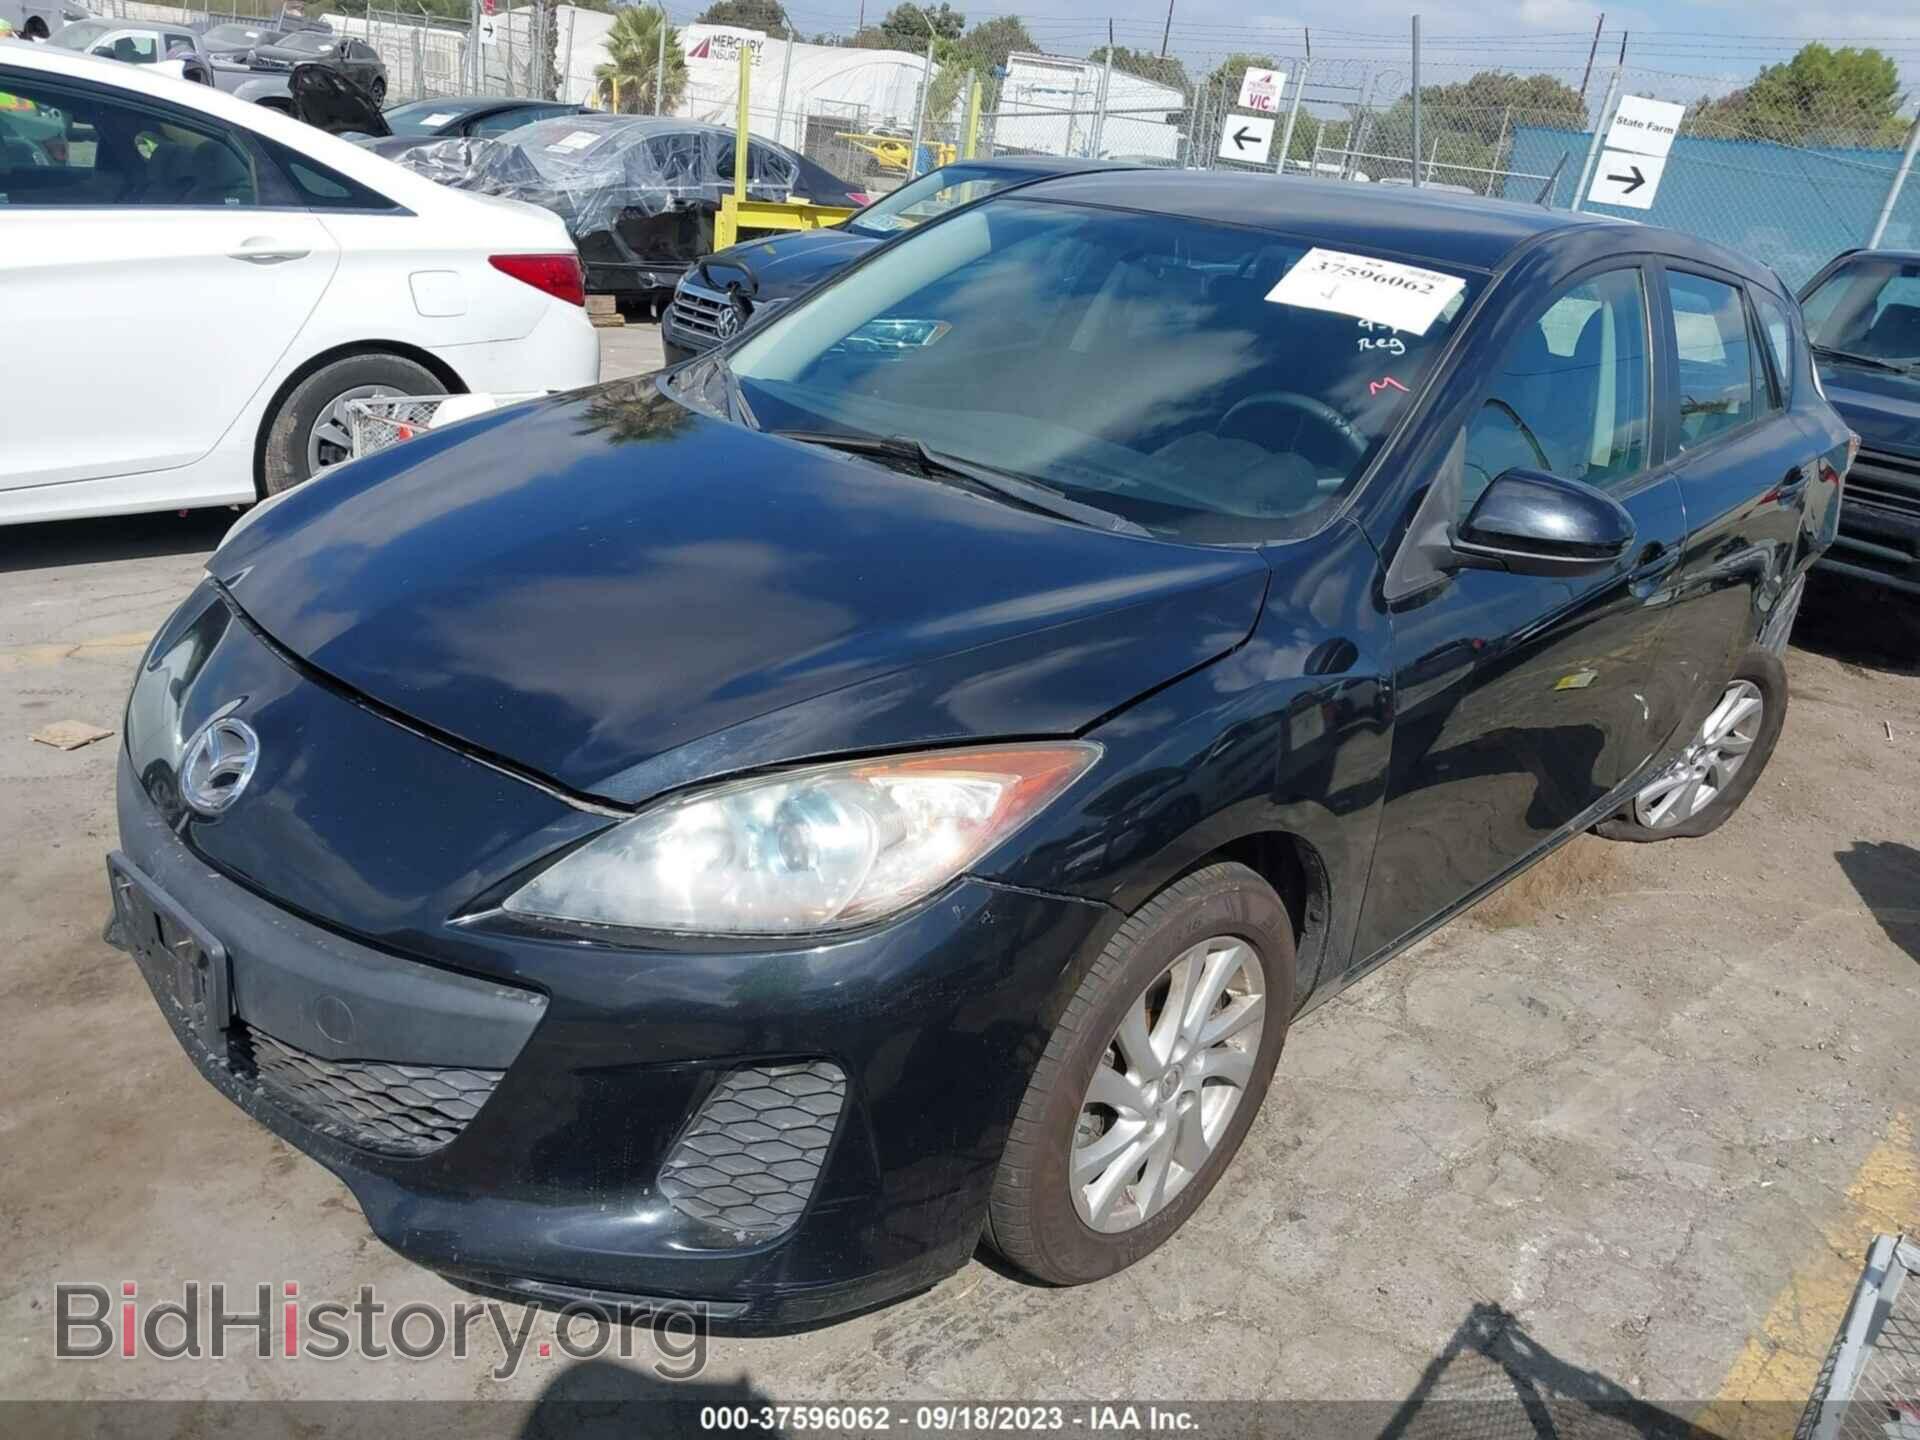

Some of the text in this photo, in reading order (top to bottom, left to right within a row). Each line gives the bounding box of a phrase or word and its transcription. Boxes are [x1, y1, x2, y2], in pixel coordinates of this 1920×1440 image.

[712, 34, 764, 53] MERCURY
[711, 48, 762, 67] INSURAE
[1249, 93, 1271, 110] VIC
[1616, 115, 1674, 135] State Farm
[1311, 261, 1436, 295] 37596062
